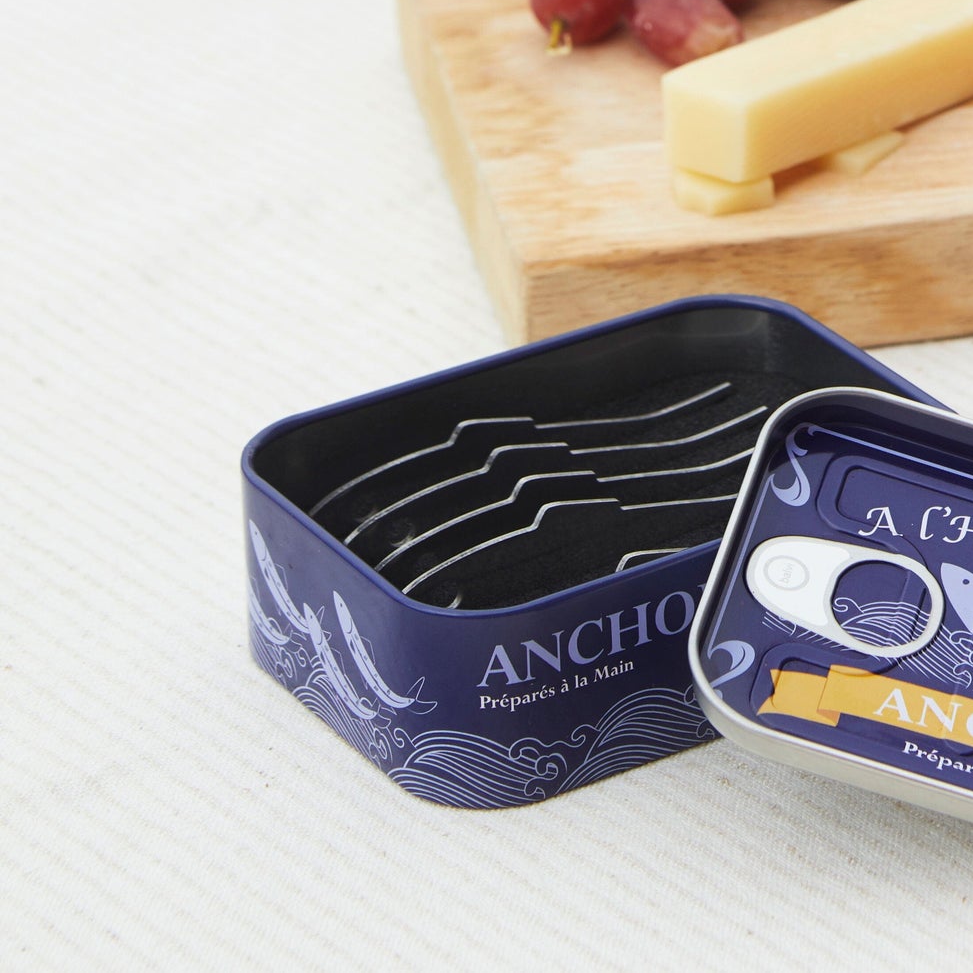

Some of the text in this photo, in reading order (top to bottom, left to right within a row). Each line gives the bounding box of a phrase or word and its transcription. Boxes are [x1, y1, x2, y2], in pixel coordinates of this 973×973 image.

[858, 506, 903, 537] A
[476, 582, 707, 687] ANCHO
[479, 658, 635, 712] Préparés à la Main
